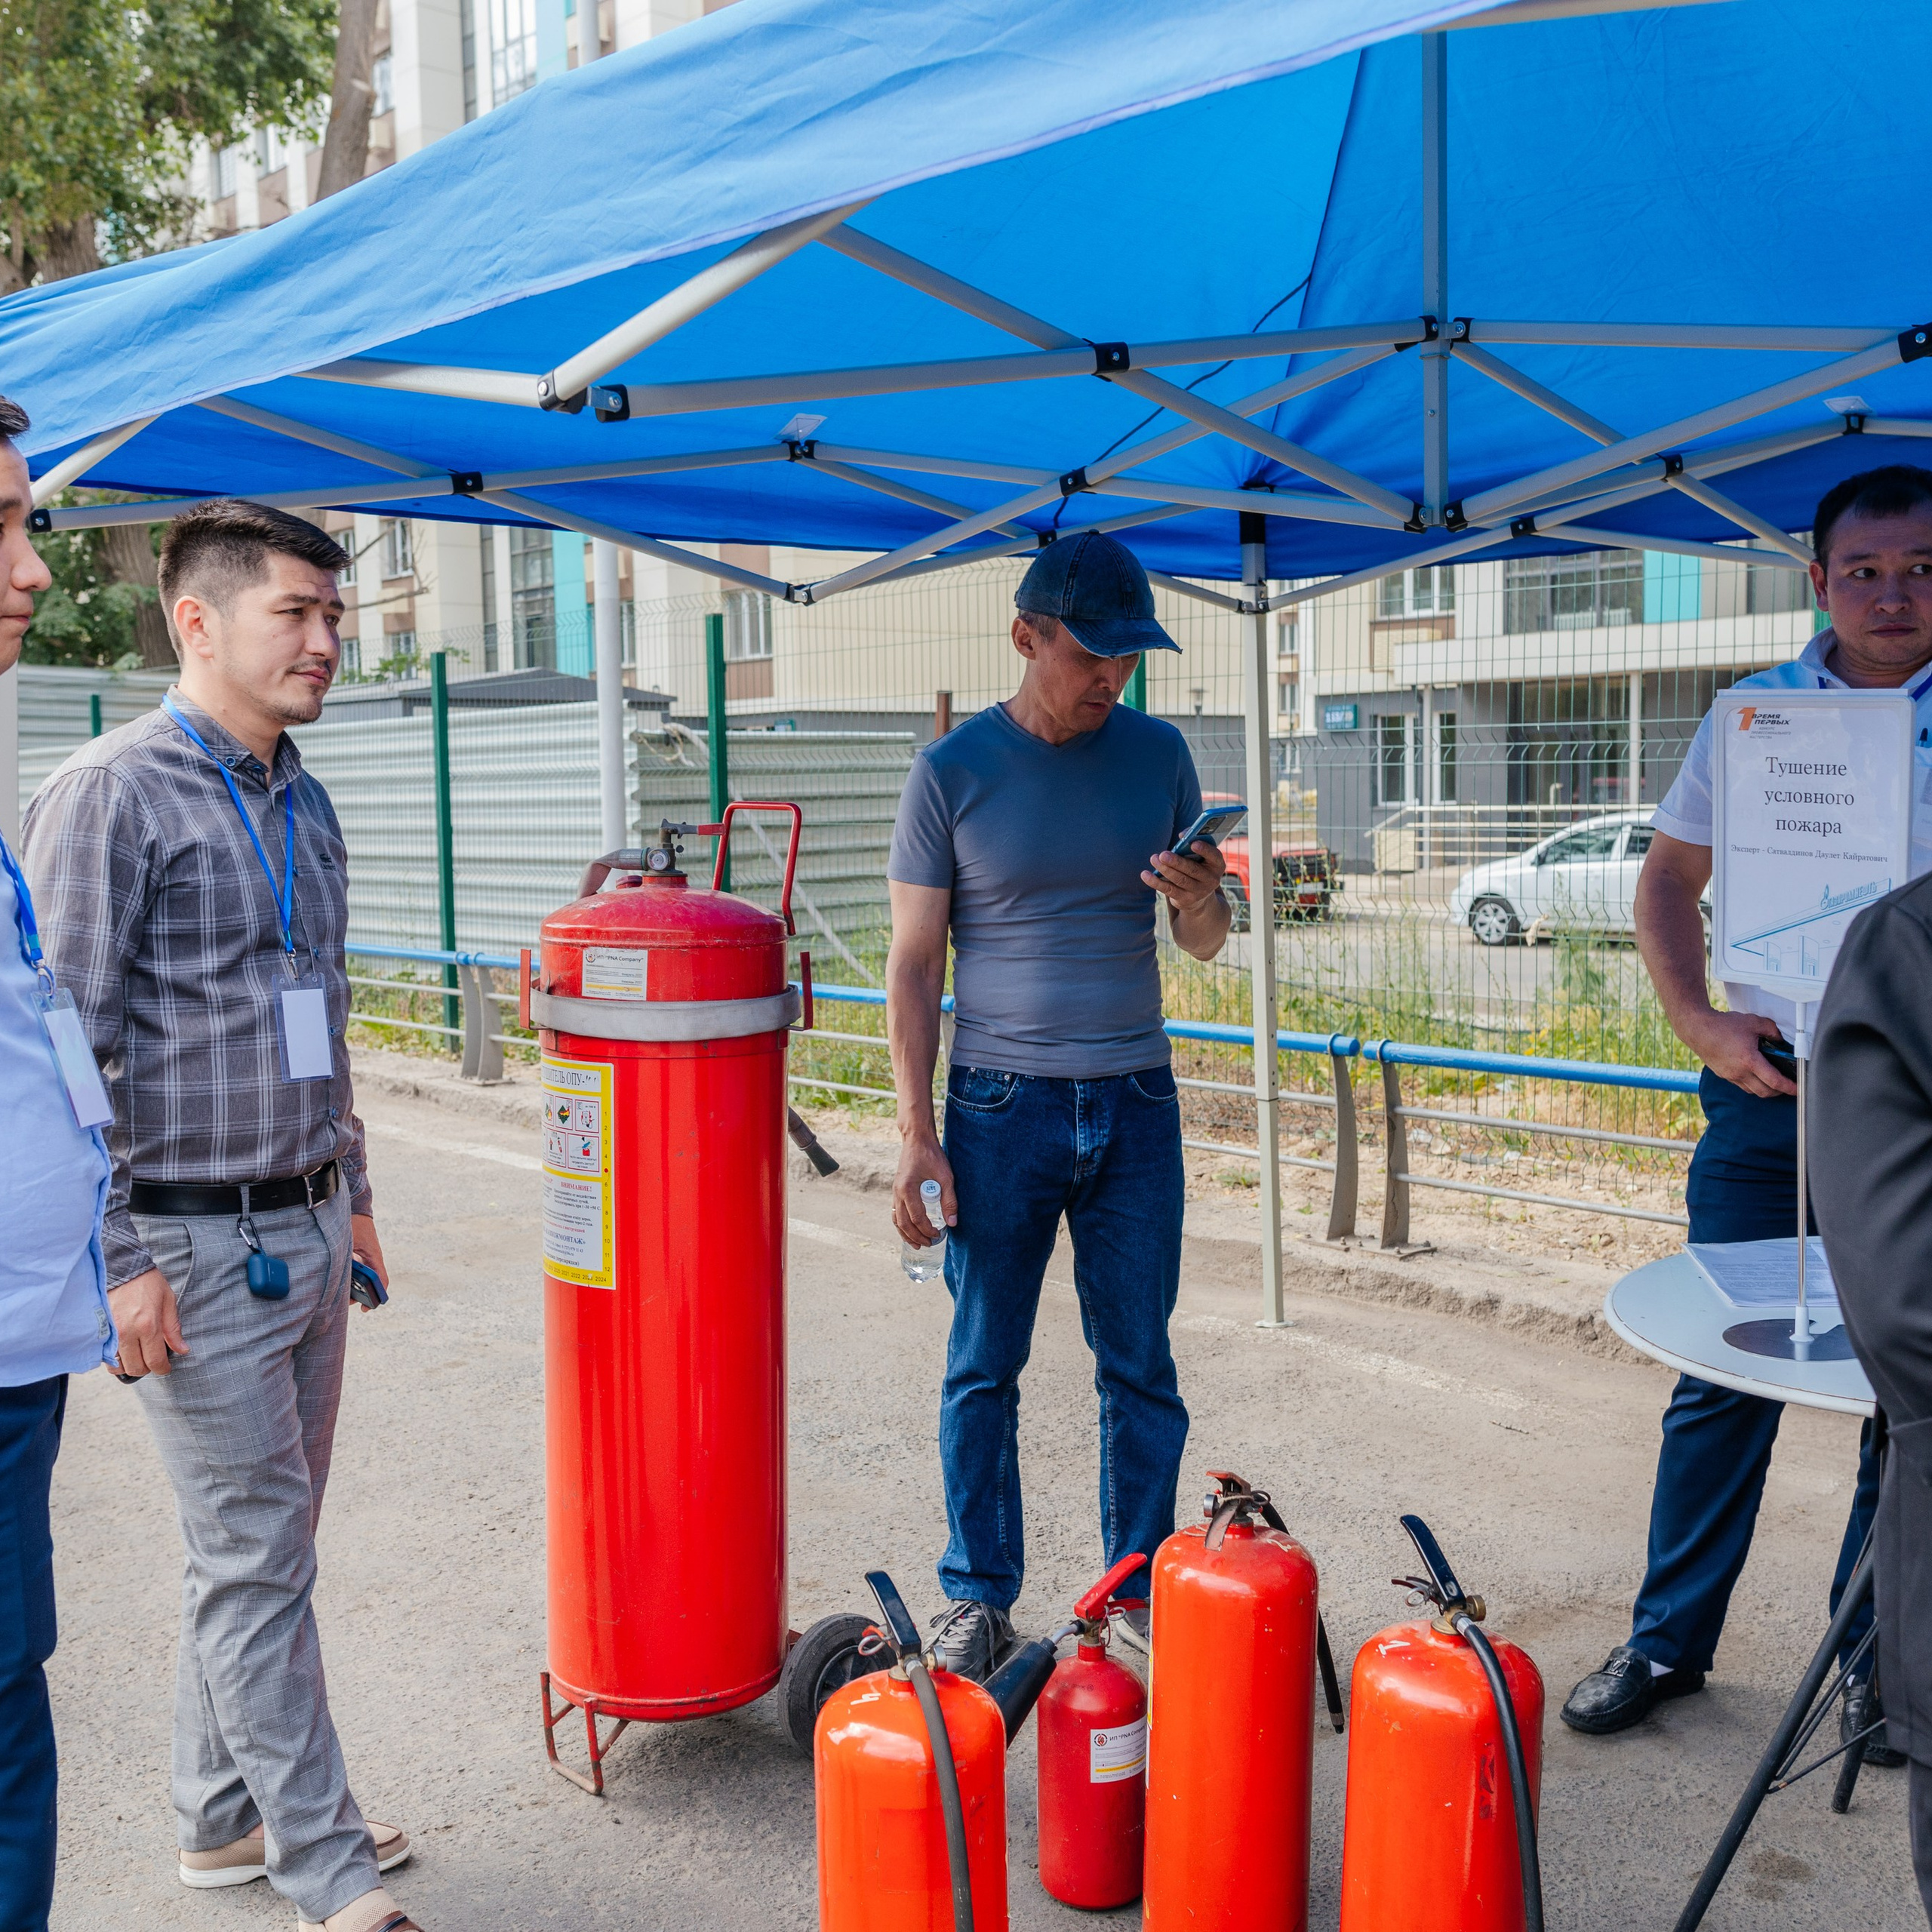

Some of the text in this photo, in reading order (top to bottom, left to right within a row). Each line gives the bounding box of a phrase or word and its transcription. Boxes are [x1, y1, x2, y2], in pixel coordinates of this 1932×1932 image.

[1764, 756, 1847, 778] Тушение
[1764, 790, 1854, 806] условного
[1776, 819, 1842, 837] пожара
[1730, 844, 1761, 855] Эксперт
[1814, 850, 1841, 860] Даулет
[1842, 851, 1888, 863] Кайратович
[561, 1181, 592, 1192] ВНИМАНИЕ!
